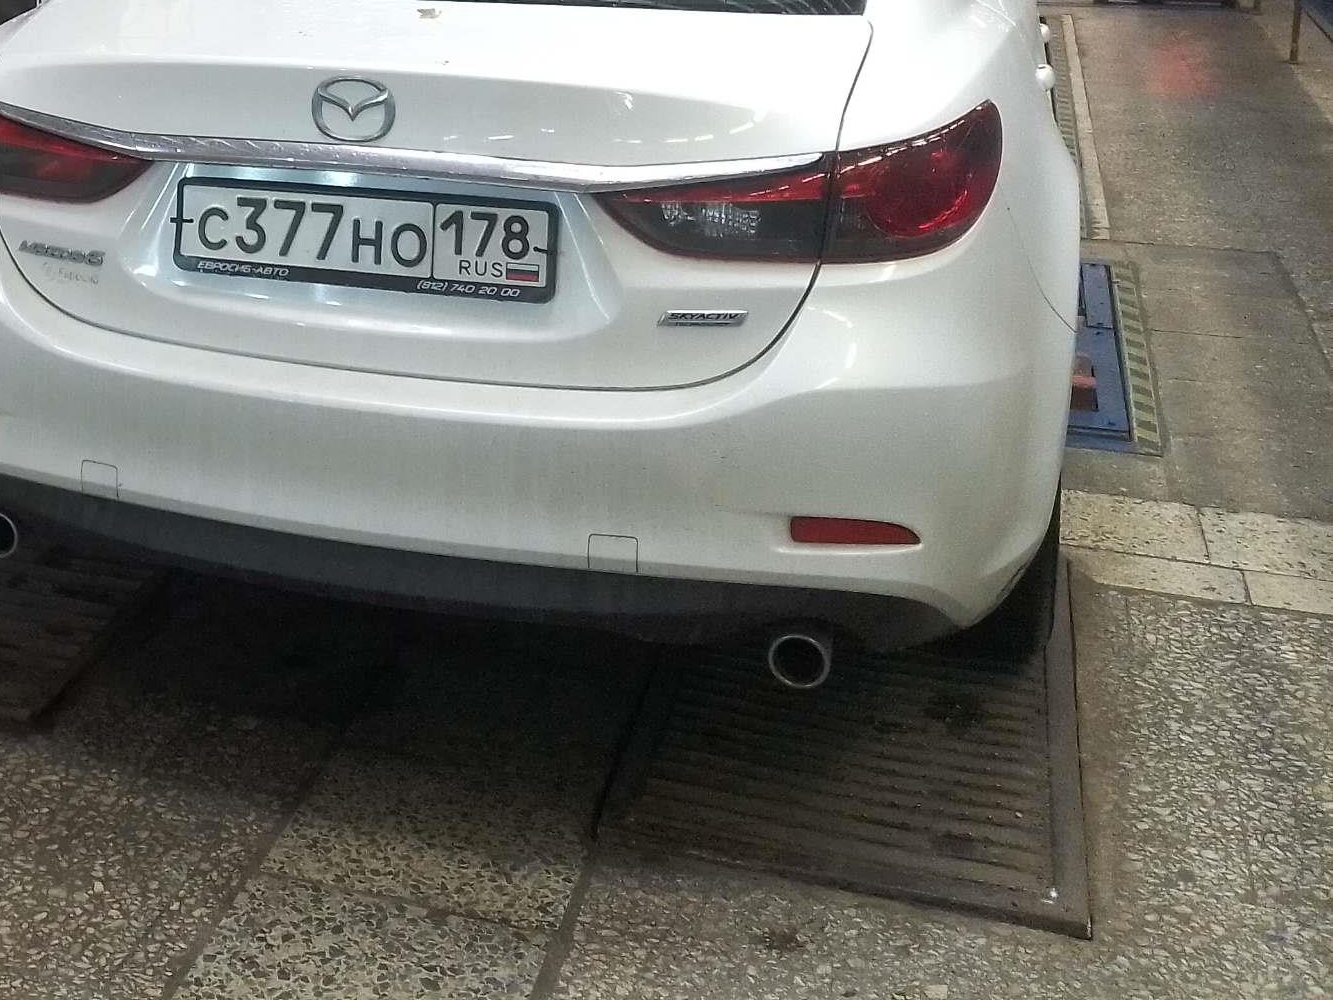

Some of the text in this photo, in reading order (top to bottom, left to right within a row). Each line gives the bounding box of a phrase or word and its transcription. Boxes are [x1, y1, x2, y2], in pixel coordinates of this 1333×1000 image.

[198, 197, 530, 268] С377НО 178
[458, 259, 504, 279] RUS
[450, 282, 476, 295] 740
[479, 285, 498, 296] 20
[500, 286, 520, 298] 00
[667, 312, 739, 321] SKYACTIV
